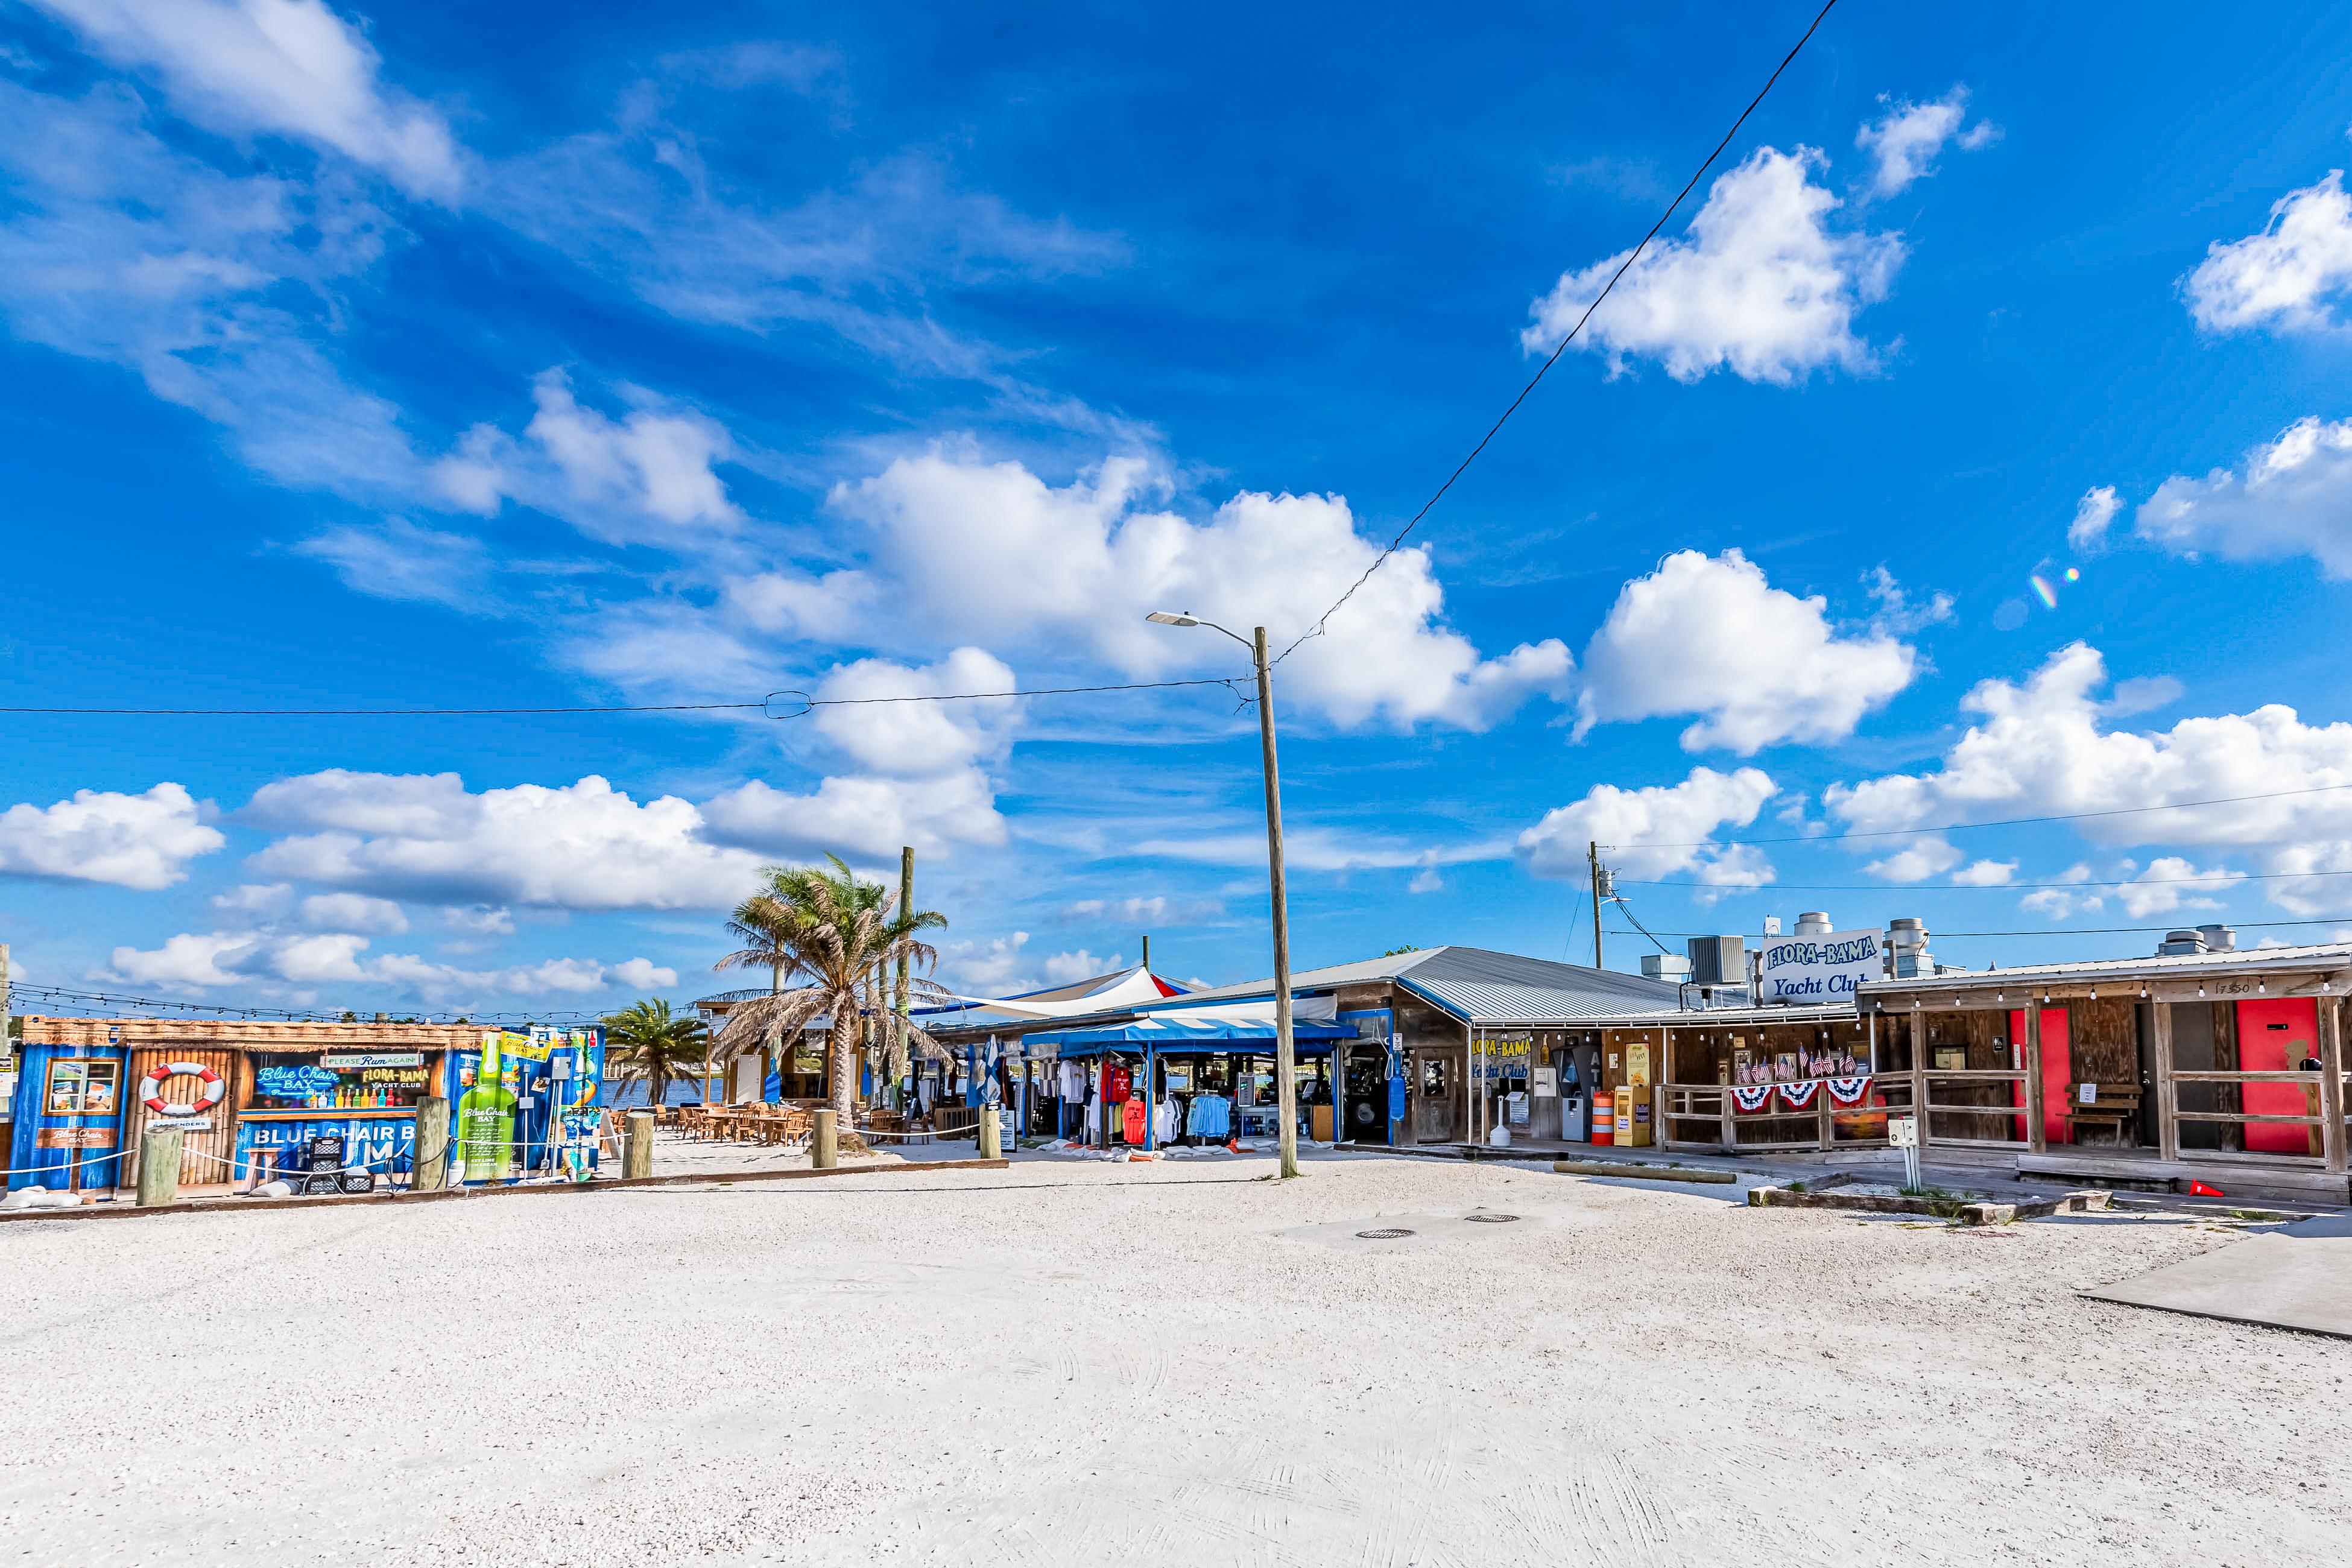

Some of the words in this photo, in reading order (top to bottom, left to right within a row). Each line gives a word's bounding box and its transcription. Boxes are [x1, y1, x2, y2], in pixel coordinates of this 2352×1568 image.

[1767, 935, 1877, 970] FLORA-BAMA
[1774, 977, 1822, 996] Yacht
[1472, 1037, 1531, 1057] LORA-BAMA
[360, 1055, 387, 1065] Rum
[257, 1066, 296, 1081] Blue
[299, 1065, 340, 1083] Chair
[362, 1068, 429, 1083] FLORA-BAMA
[1502, 1064, 1528, 1078] Club
[283, 1080, 315, 1089] BAY
[463, 1107, 485, 1118] Blue
[485, 1107, 510, 1117] Chair
[52, 1130, 78, 1140] Blue
[78, 1130, 104, 1139] Chair
[254, 1128, 317, 1144] BLUE
[327, 1127, 396, 1140] CHAIR
